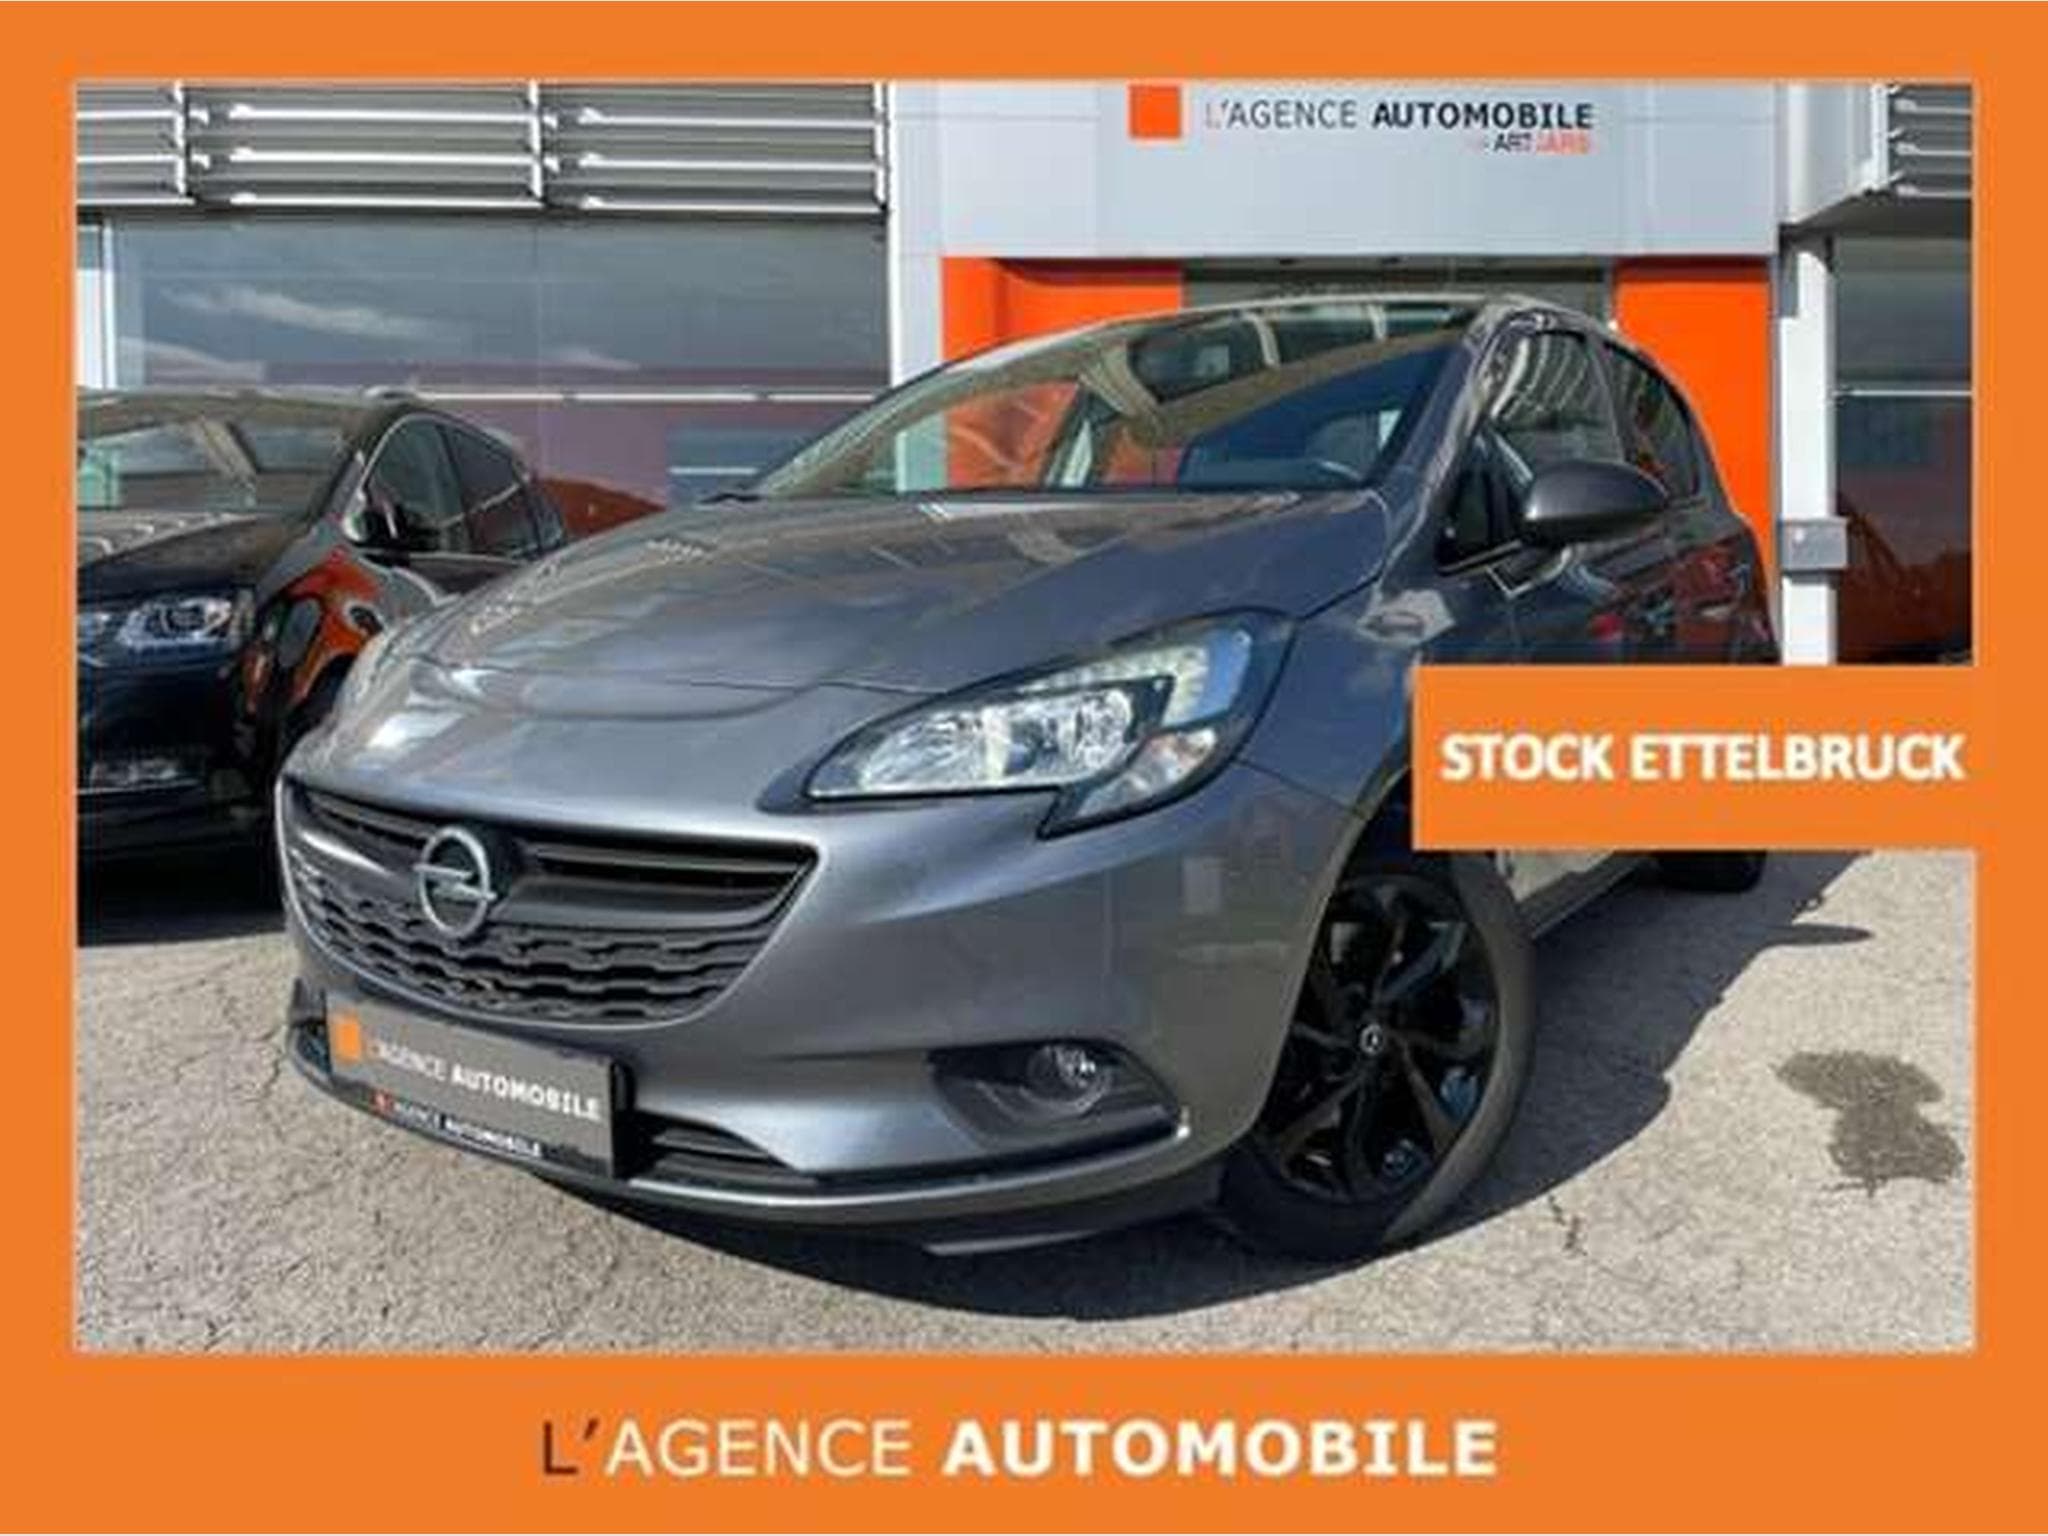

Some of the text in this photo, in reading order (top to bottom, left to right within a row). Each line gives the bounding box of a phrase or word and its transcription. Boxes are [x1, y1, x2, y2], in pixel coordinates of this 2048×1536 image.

[1204, 99, 1594, 129] L'AGENCE AUTOMOBILE
[453, 1064, 602, 1121] AUTOMOBILE
